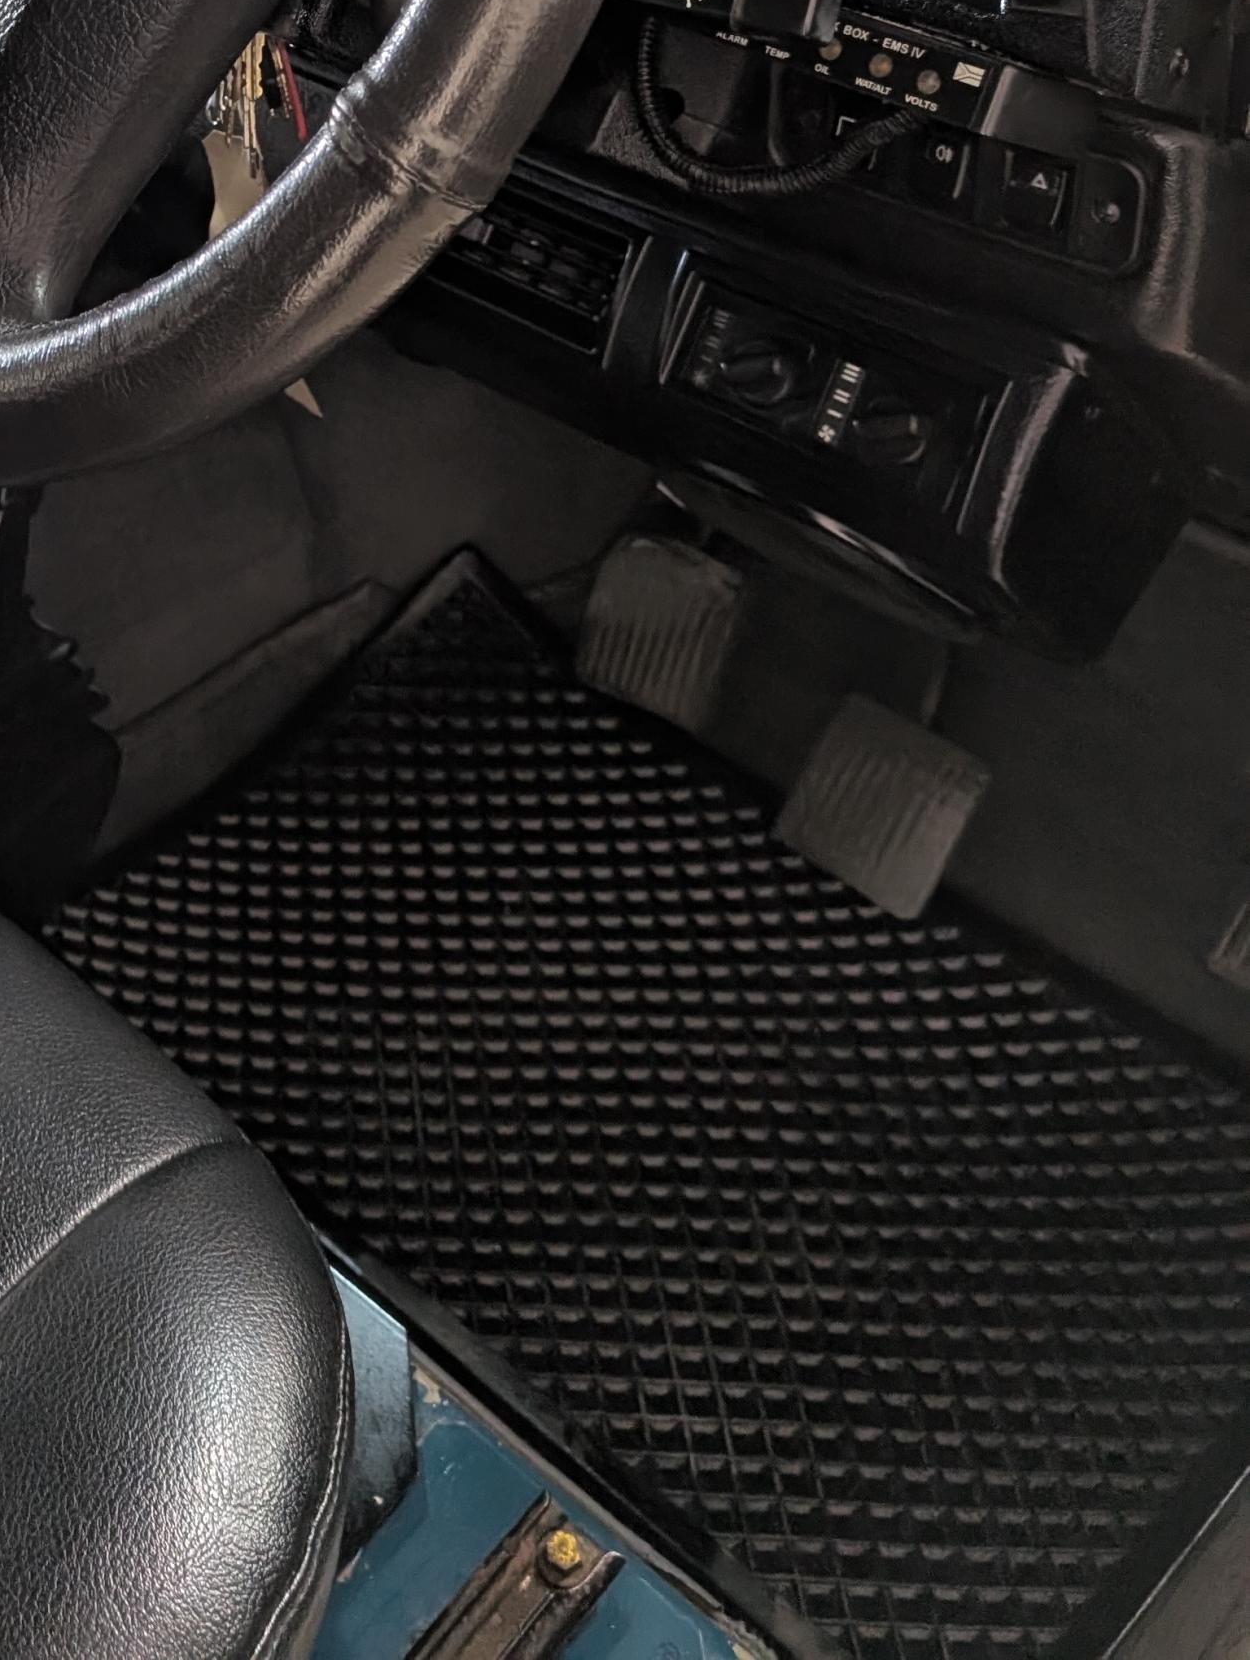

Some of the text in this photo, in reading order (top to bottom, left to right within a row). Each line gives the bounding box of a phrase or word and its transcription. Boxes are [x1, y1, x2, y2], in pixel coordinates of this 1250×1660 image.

[716, 32, 749, 47] ALARM
[843, 25, 870, 42] BOX
[882, 38, 909, 55] EMS
[909, 43, 926, 59] IV
[764, 45, 791, 62] TEMP
[814, 63, 830, 76] OIL
[904, 94, 938, 113] VOLTS
